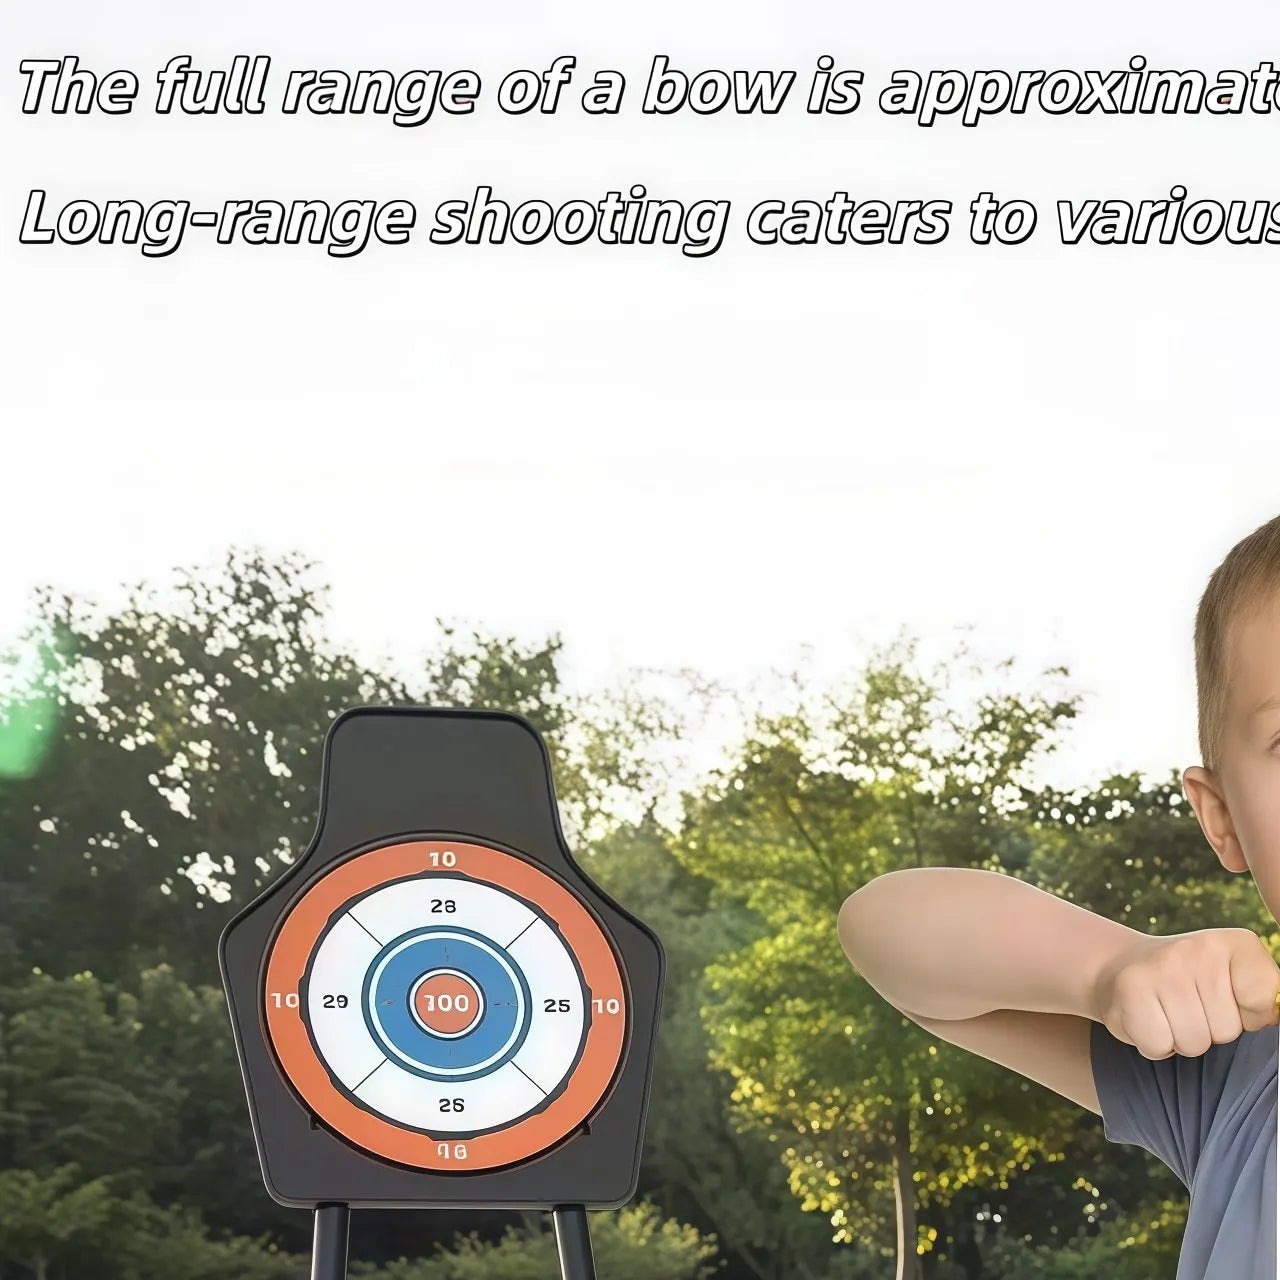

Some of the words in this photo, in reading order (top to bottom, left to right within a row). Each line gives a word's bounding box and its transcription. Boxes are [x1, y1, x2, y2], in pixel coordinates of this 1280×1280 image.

[429, 851, 457, 868] 10
[270, 992, 299, 1009] 10
[423, 994, 469, 1013] 100
[543, 998, 571, 1013] 25
[592, 999, 620, 1015] 10
